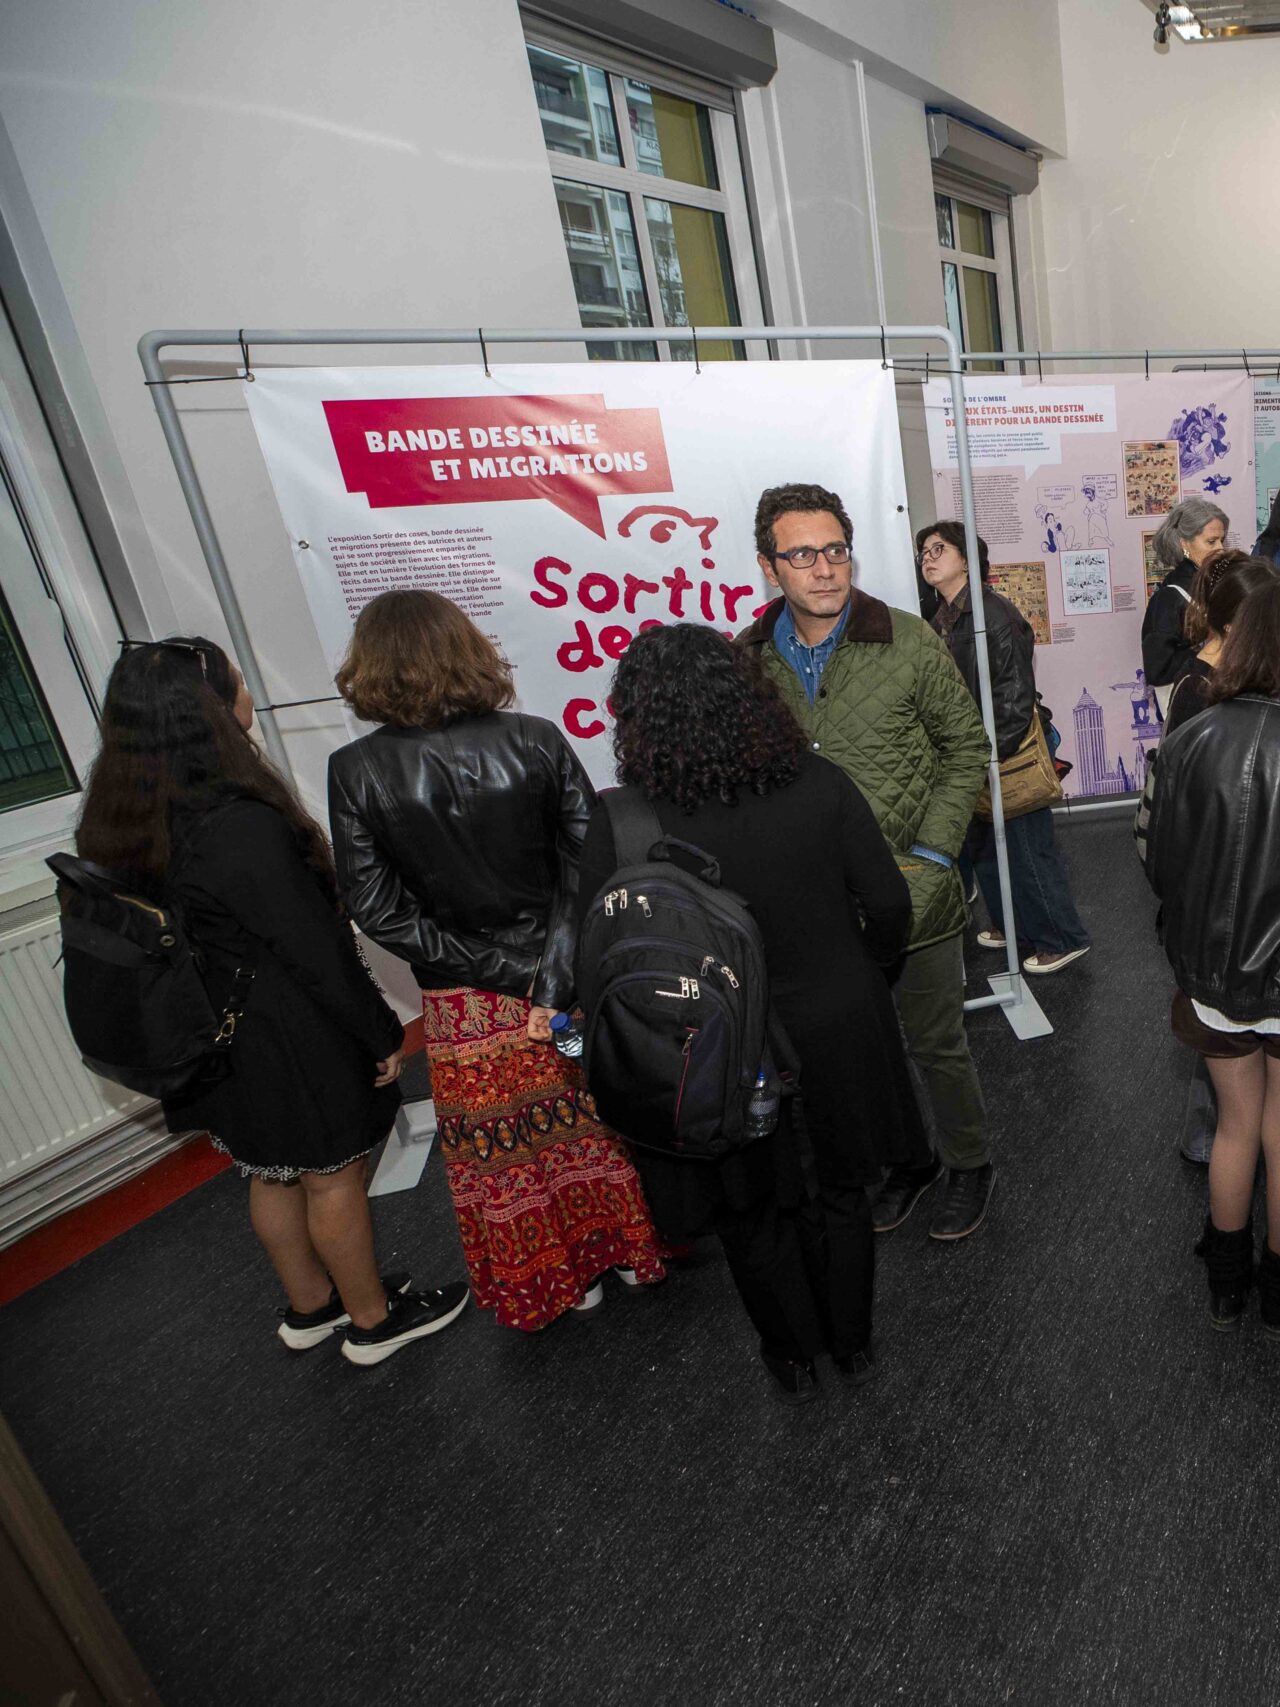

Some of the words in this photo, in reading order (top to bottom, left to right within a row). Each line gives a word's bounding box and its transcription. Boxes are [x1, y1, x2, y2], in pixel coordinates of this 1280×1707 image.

[945, 408, 950, 416] 3
[1054, 404, 1084, 412] DESTIN
[995, 417, 1018, 425] POUR
[1034, 416, 1061, 424] BANDE
[1064, 414, 1104, 423] DESSINÉE
[365, 428, 464, 453] BANDE
[469, 419, 599, 449] DESSINÉE
[430, 459, 461, 481] ET
[469, 451, 648, 480] MIGRATIONS
[328, 535, 371, 543] L'exposition
[373, 532, 393, 540] Sortir
[454, 527, 484, 535] dessinée
[340, 542, 378, 551] migrations
[380, 540, 411, 549] présente
[375, 547, 434, 558] progressivement
[436, 544, 465, 553] emparés
[336, 561, 358, 570] sujets
[371, 558, 396, 566] société
[453, 552, 492, 562] migrations.
[380, 566, 407, 574] lumière
[409, 564, 445, 572] l'évolution
[461, 560, 485, 568] formes
[341, 578, 361, 586] récits
[390, 574, 412, 582] bande
[414, 572, 446, 580] dessinée.
[463, 568, 494, 577] distingue
[412, 581, 438, 589] histoire
[463, 577, 488, 585] déploie
[530, 556, 753, 622] Sortir
[469, 601, 504, 610] l'évolution
